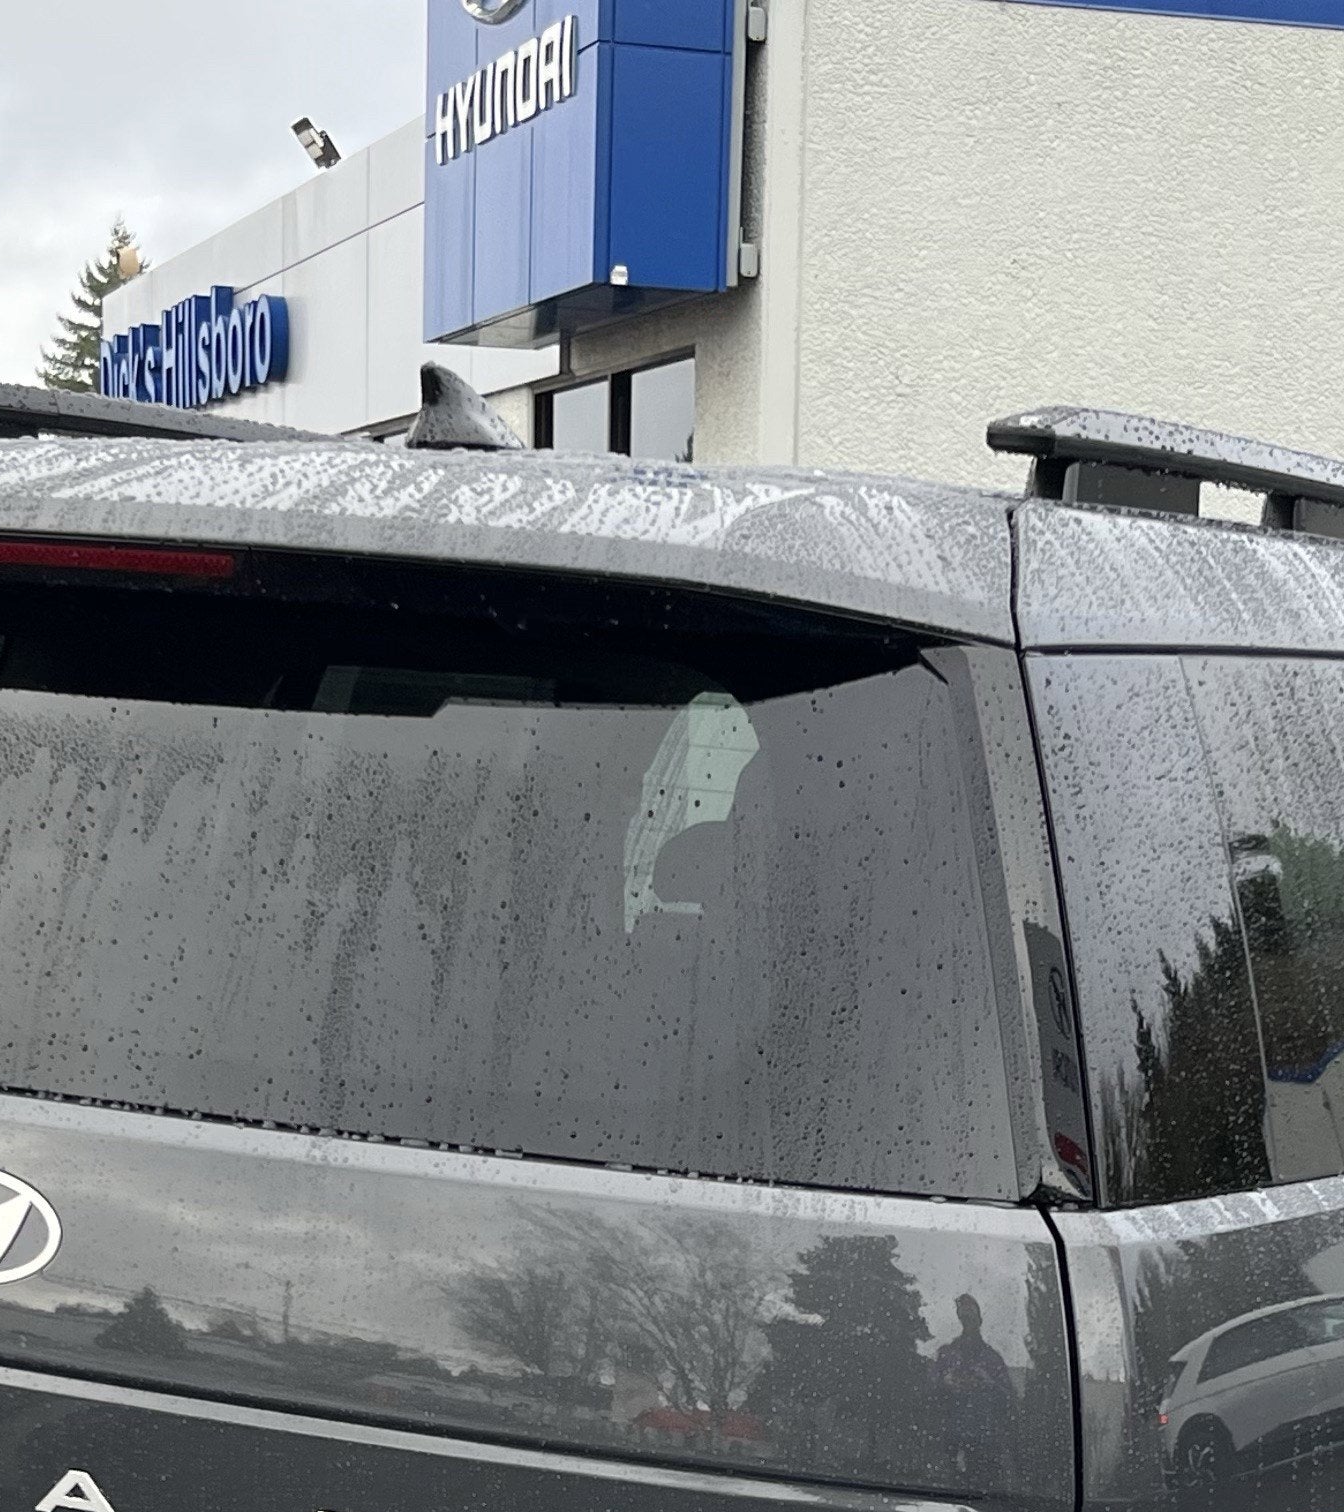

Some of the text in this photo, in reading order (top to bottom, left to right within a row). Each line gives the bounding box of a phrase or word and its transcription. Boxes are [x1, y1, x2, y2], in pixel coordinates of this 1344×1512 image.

[435, 15, 577, 165] HYUNDAI
[100, 286, 274, 409] Dick's Hillsboro
